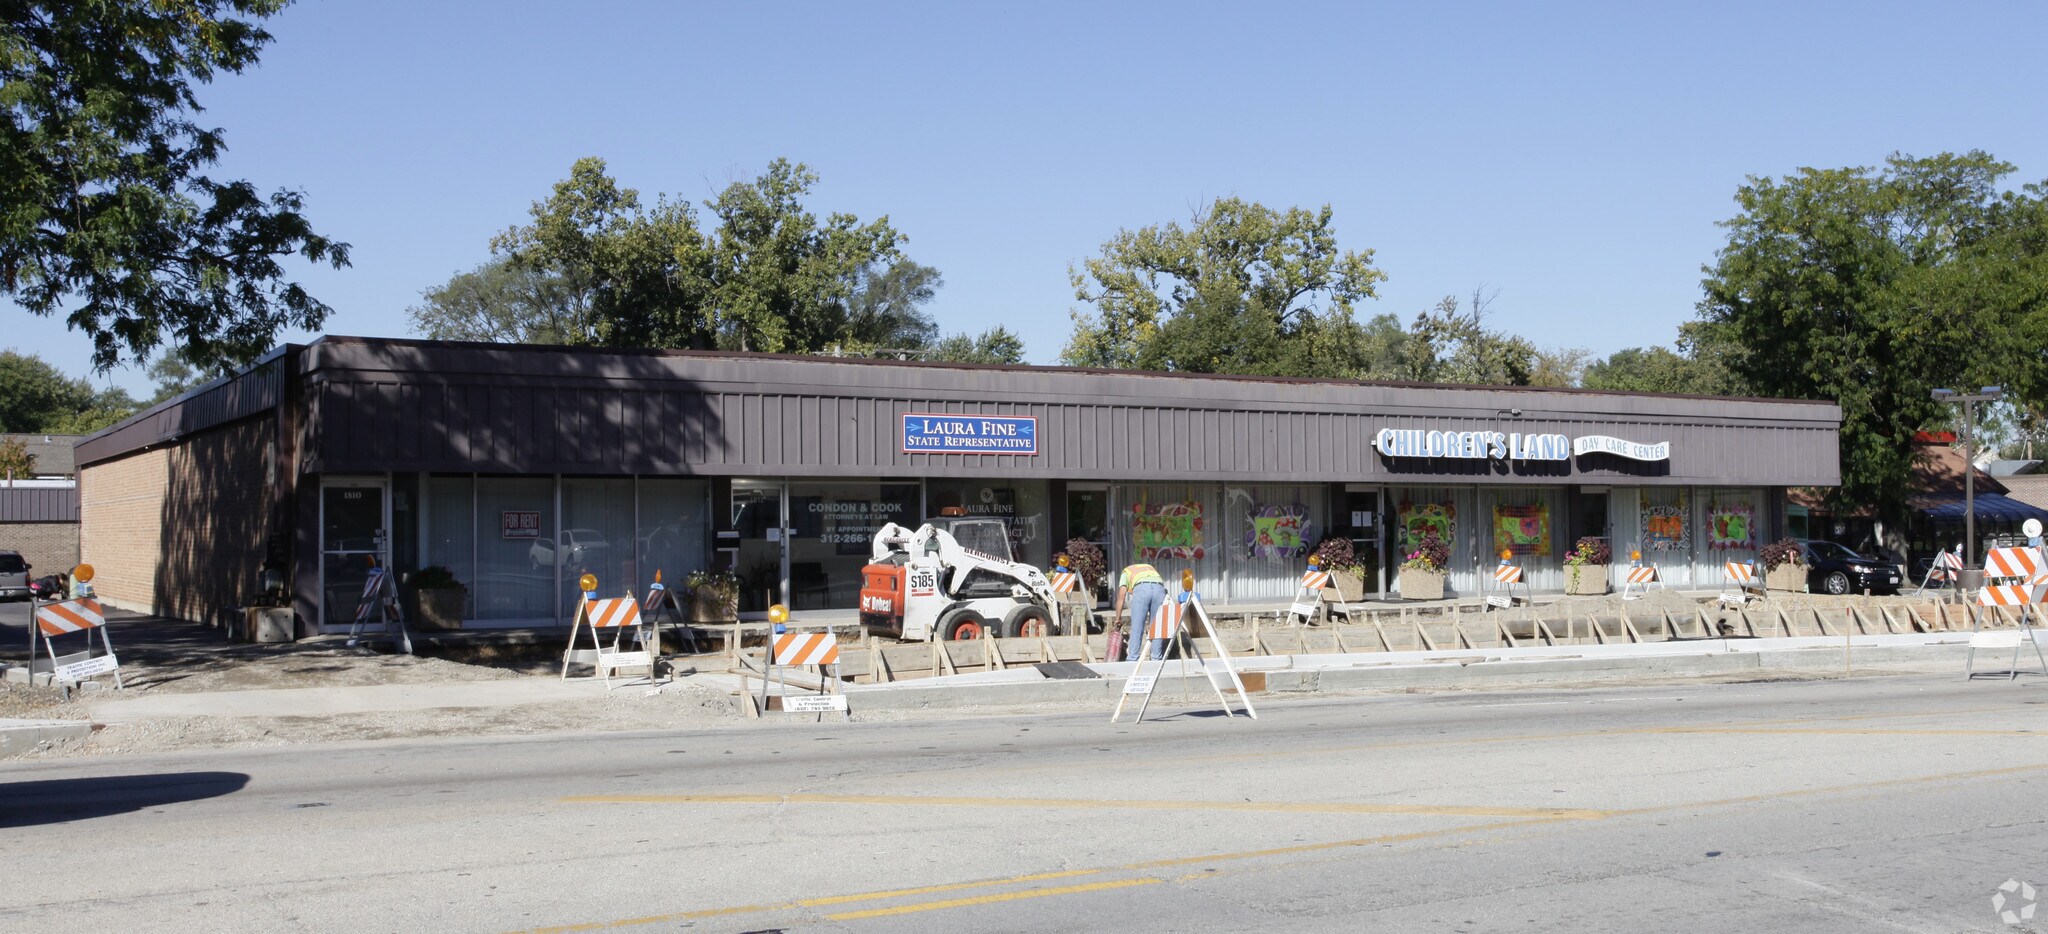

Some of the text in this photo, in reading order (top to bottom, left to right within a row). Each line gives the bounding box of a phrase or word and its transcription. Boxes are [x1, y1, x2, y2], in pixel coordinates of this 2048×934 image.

[923, 419, 1017, 436] LAURA FINE
[907, 435, 1032, 448] STATE REPRESENTATIVE
[1377, 428, 1569, 460] CHILDREN'S LAND
[1582, 438, 1666, 459] DAY CARE CENTER
[344, 491, 362, 499] 1810
[808, 503, 903, 512] CONDON & COOK
[961, 503, 1014, 513] AURA FINE
[505, 513, 538, 528] FOR RENT
[911, 574, 934, 588] S185
